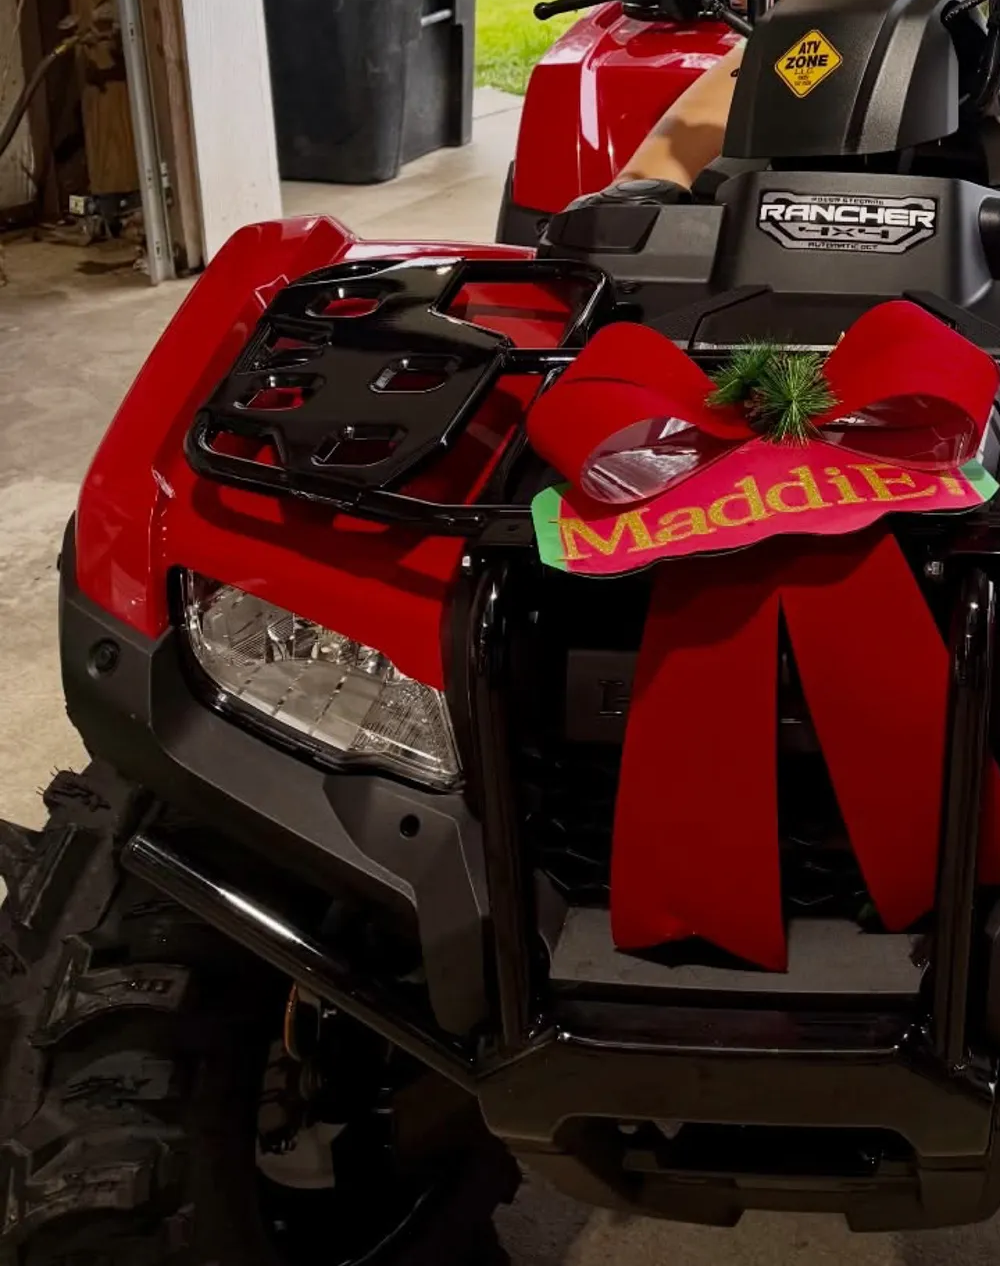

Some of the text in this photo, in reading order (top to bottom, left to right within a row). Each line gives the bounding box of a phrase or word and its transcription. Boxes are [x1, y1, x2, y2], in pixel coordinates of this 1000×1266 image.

[798, 40, 821, 55] ATV
[785, 54, 829, 70] ZONE
[760, 204, 936, 228] RANCHER
[808, 241, 858, 250] AUTOMATIC
